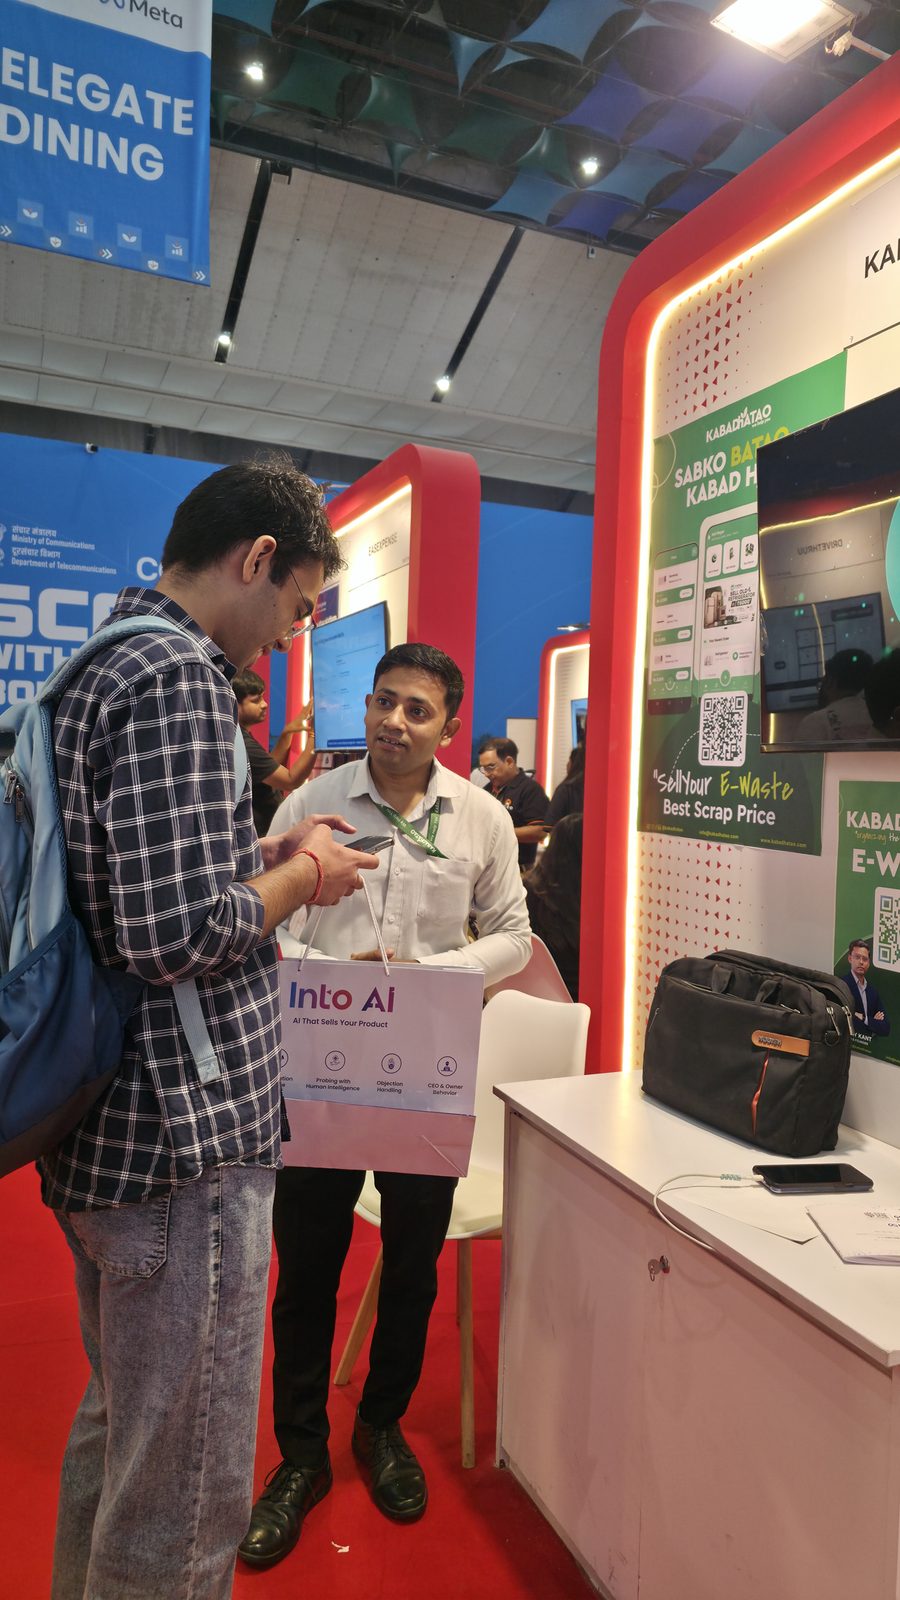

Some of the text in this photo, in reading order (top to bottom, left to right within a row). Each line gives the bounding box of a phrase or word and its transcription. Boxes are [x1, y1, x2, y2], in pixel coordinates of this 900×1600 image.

[130, 0, 183, 28] Meta
[2, 47, 194, 136] ELEGATE
[0, 104, 164, 182] DINING
[864, 238, 900, 279] KA
[674, 451, 727, 488] SABKO
[687, 470, 742, 508] KABAD
[11, 534, 37, 545] Ministry
[45, 538, 95, 551] Communications
[11, 557, 117, 575] Department of Telecommunications
[137, 556, 163, 581] C
[720, 770, 794, 801] E-Waste
[663, 798, 776, 825] Best Scrap Price
[289, 981, 353, 1011] Into
[302, 1017, 319, 1025] That
[321, 1018, 338, 1026] Sells
[340, 1019, 357, 1027] Your
[358, 1020, 388, 1028] Product
[316, 1077, 338, 1085] Probing
[328, 1084, 360, 1092] Intelligence
